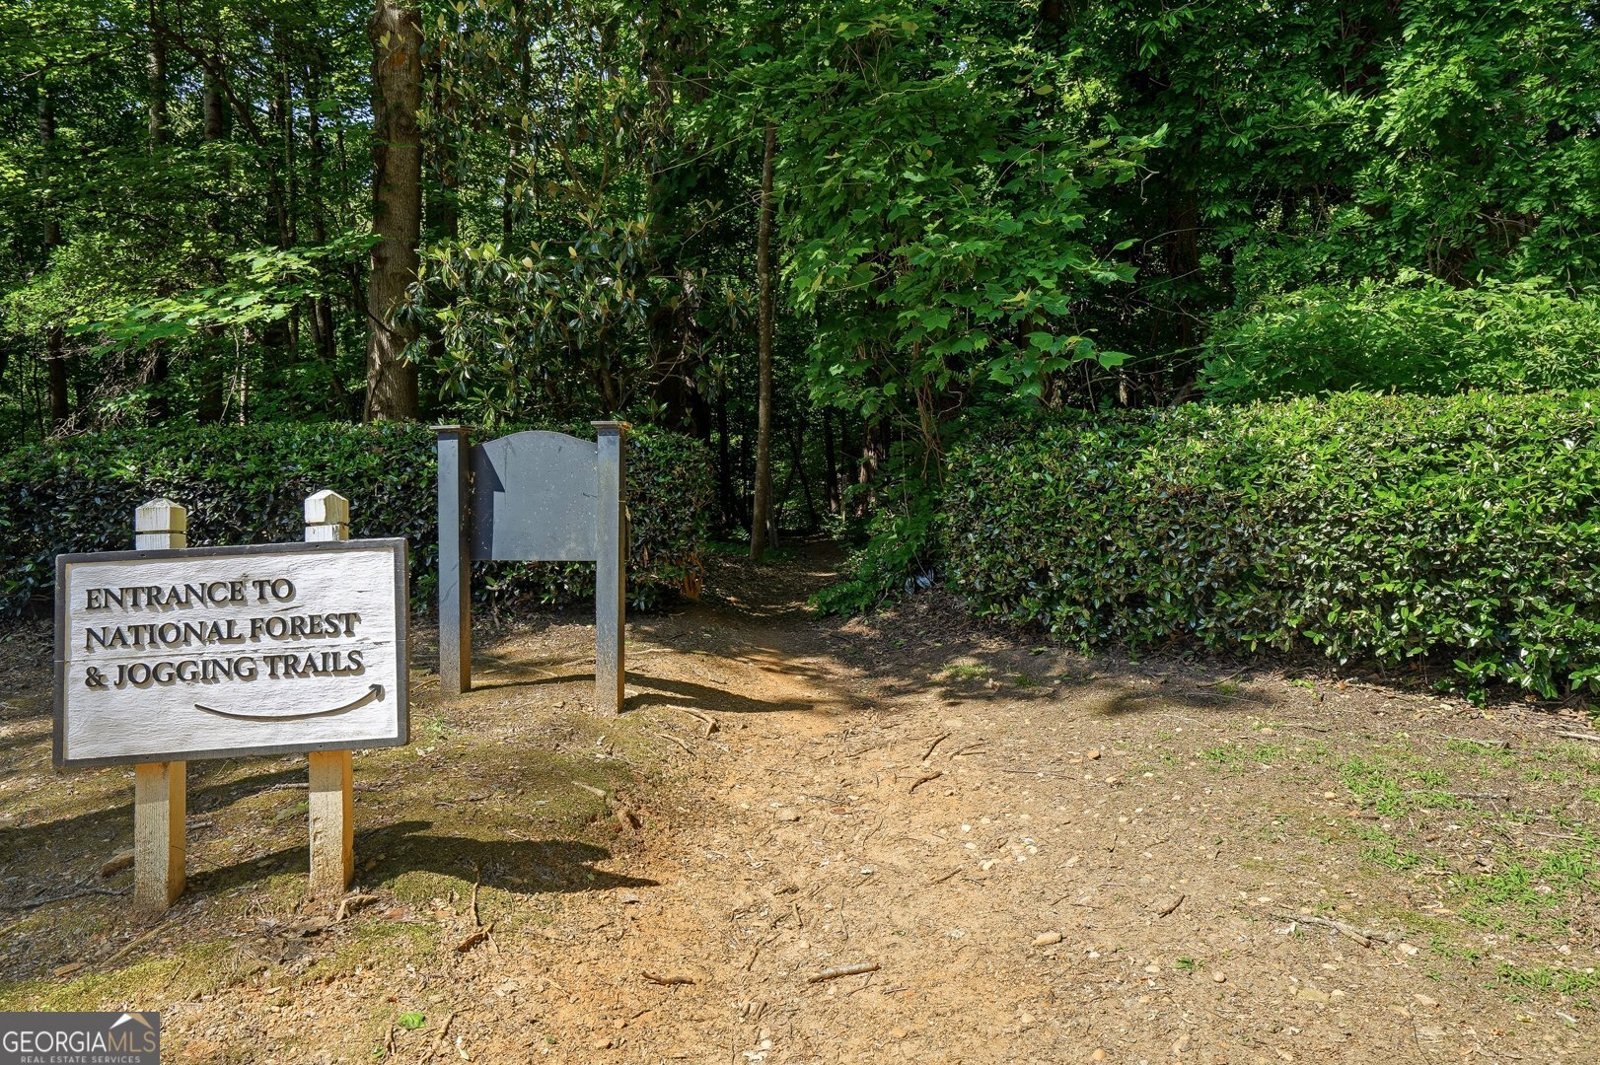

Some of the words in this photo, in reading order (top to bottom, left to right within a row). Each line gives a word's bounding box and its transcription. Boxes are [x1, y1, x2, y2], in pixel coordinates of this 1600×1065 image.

[85, 580, 245, 610] ENTRANCE
[252, 578, 294, 601] TO
[84, 619, 243, 650] NATIONAL
[250, 612, 362, 639] FOREST
[85, 666, 106, 687] &
[114, 656, 257, 686] JOGGING
[263, 650, 364, 677] TRAILS
